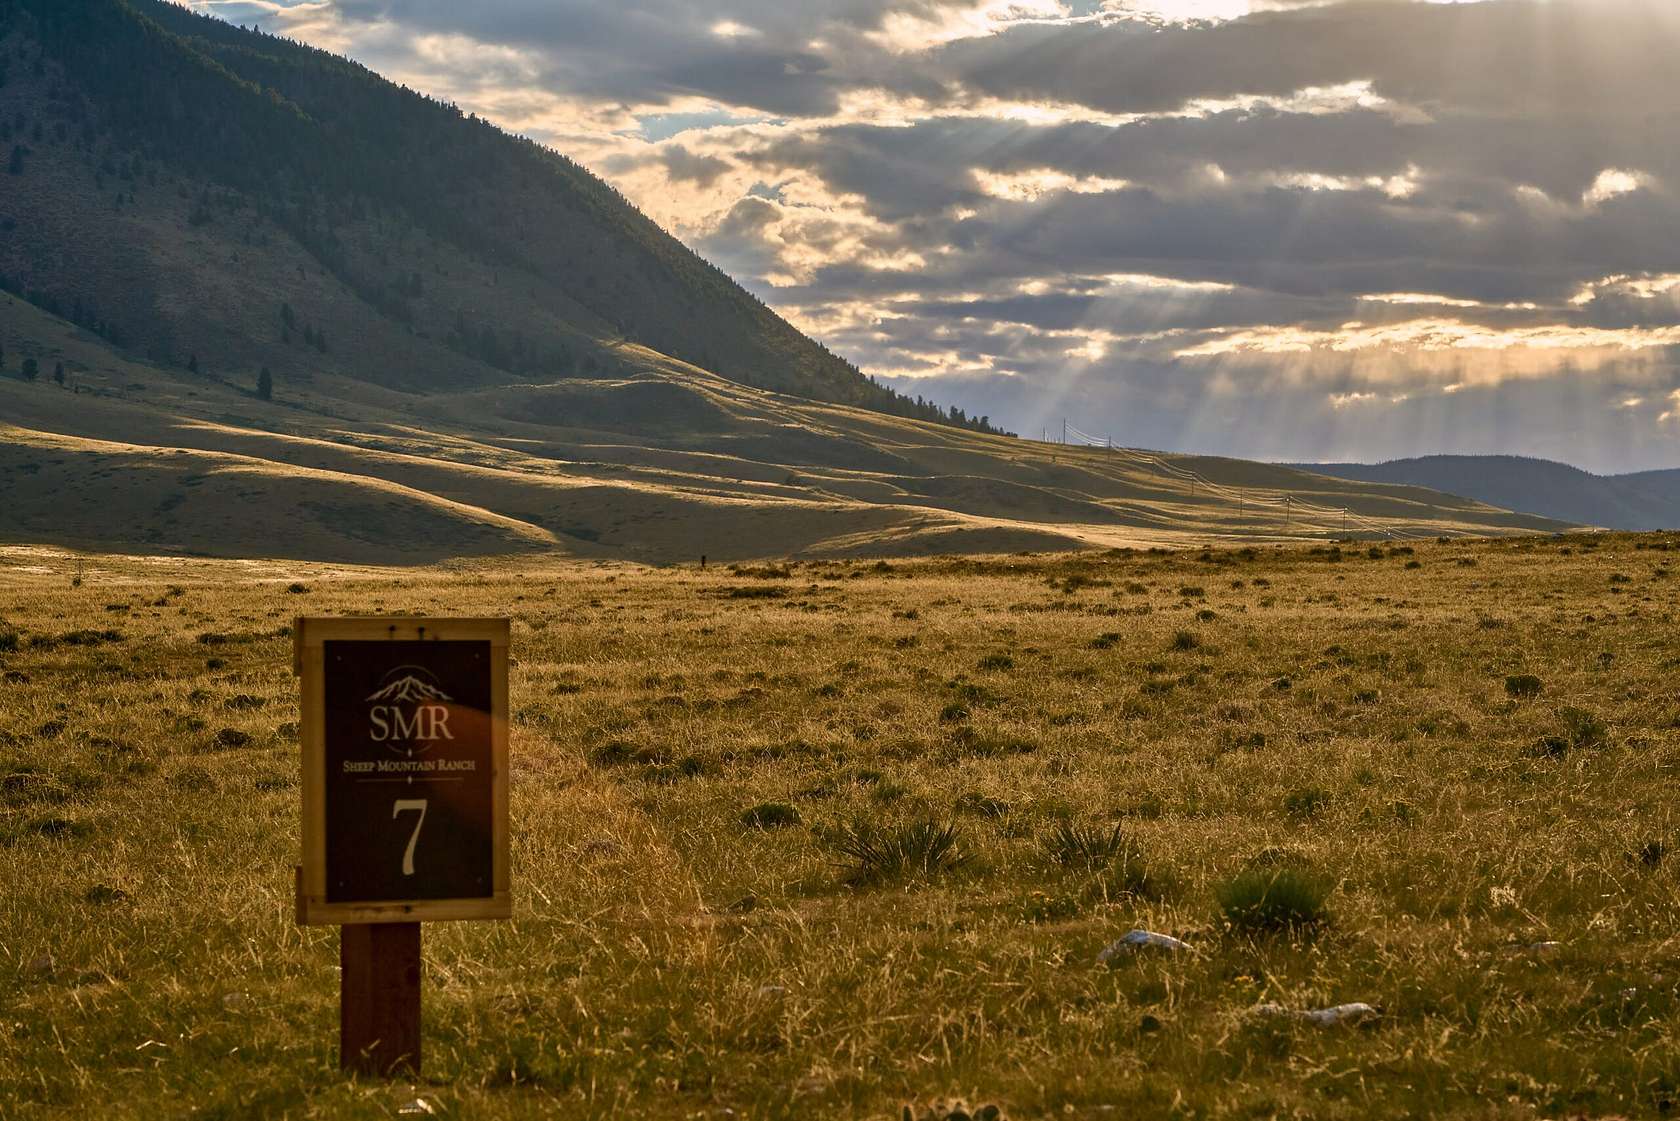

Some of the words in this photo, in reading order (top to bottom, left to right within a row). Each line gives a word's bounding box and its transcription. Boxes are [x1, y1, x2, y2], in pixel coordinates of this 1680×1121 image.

[370, 705, 455, 741] SMR
[343, 760, 375, 772] SHEEP
[377, 759, 435, 772] MOUNTAIN
[438, 758, 476, 771] RANCH
[393, 799, 427, 875] 7
